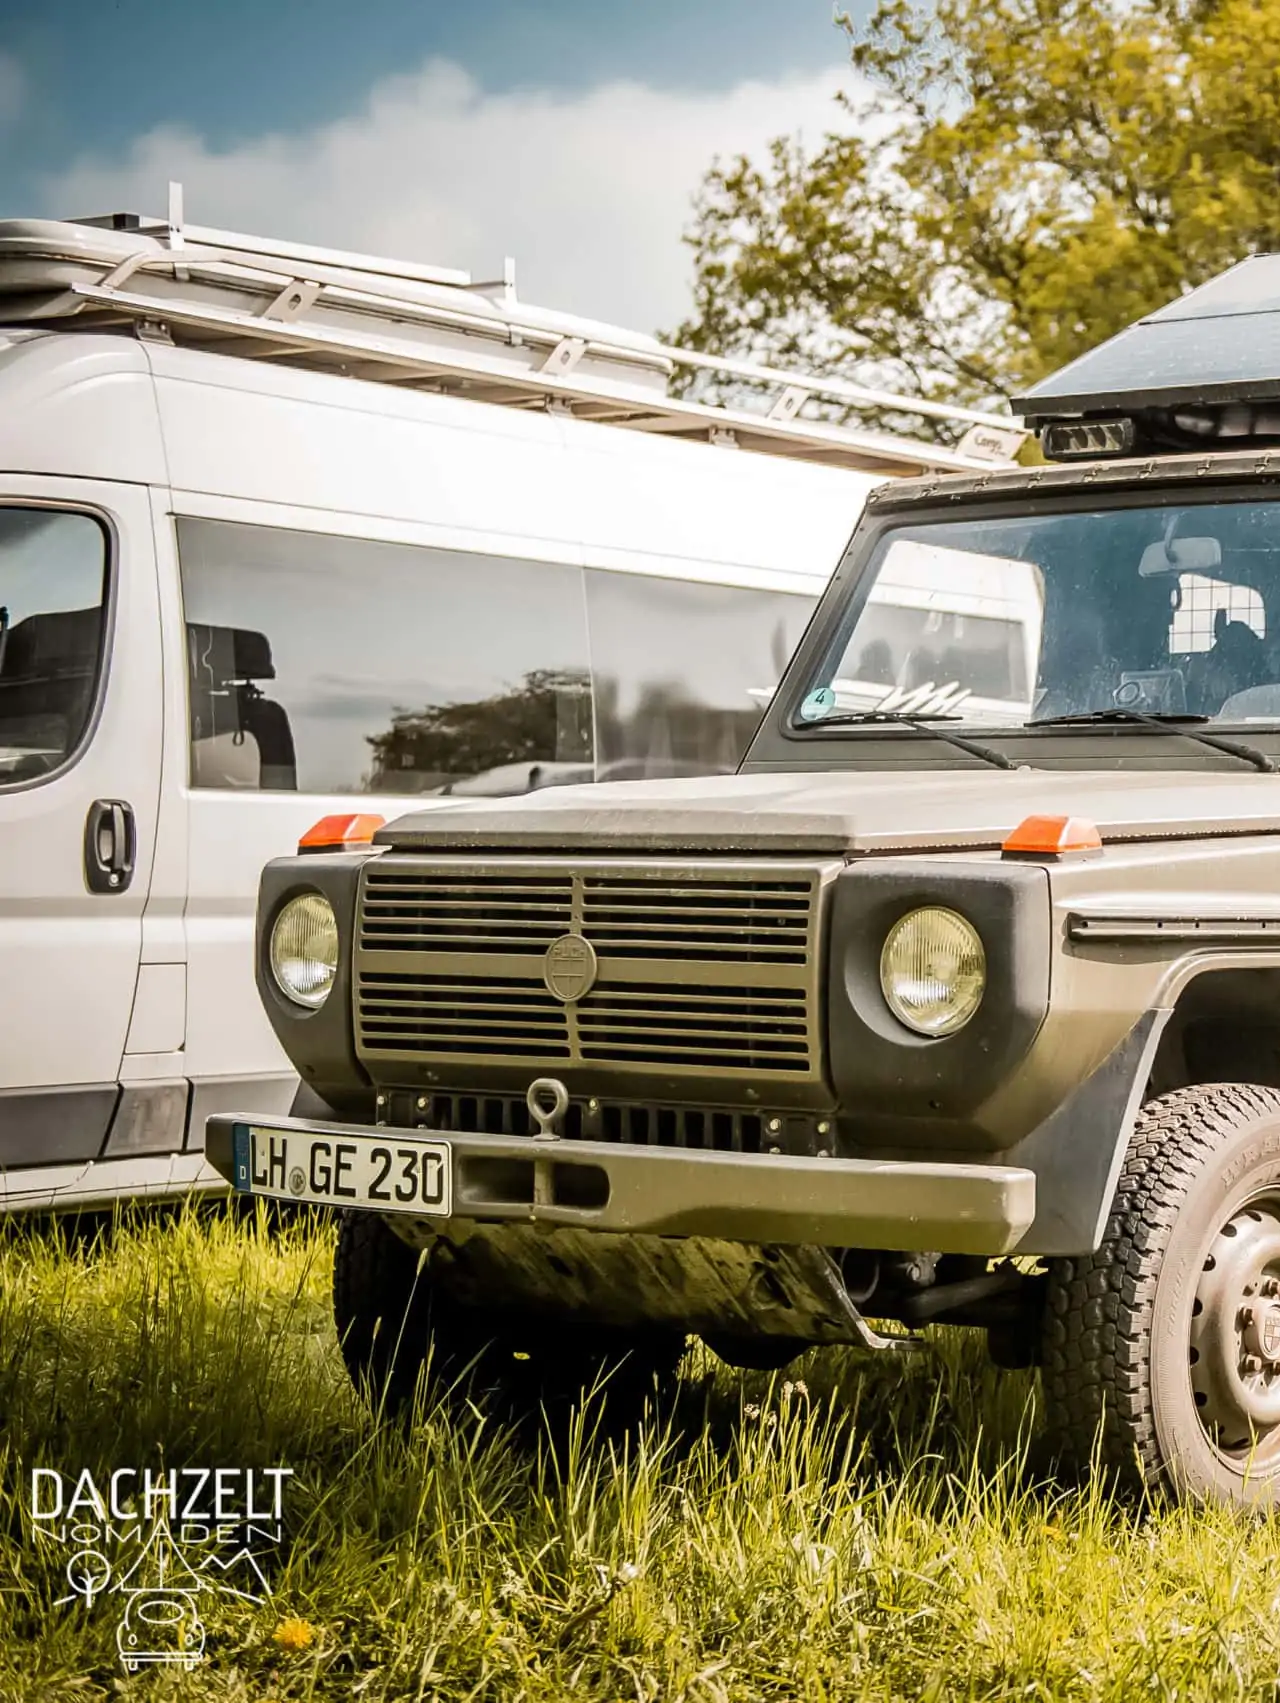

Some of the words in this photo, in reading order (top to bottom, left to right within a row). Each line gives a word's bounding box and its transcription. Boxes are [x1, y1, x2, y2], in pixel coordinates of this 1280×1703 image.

[814, 688, 826, 705] 4
[239, 1164, 247, 1180] D
[250, 1133, 288, 1190] LH
[309, 1141, 358, 1199] GE
[367, 1147, 445, 1205] 230
